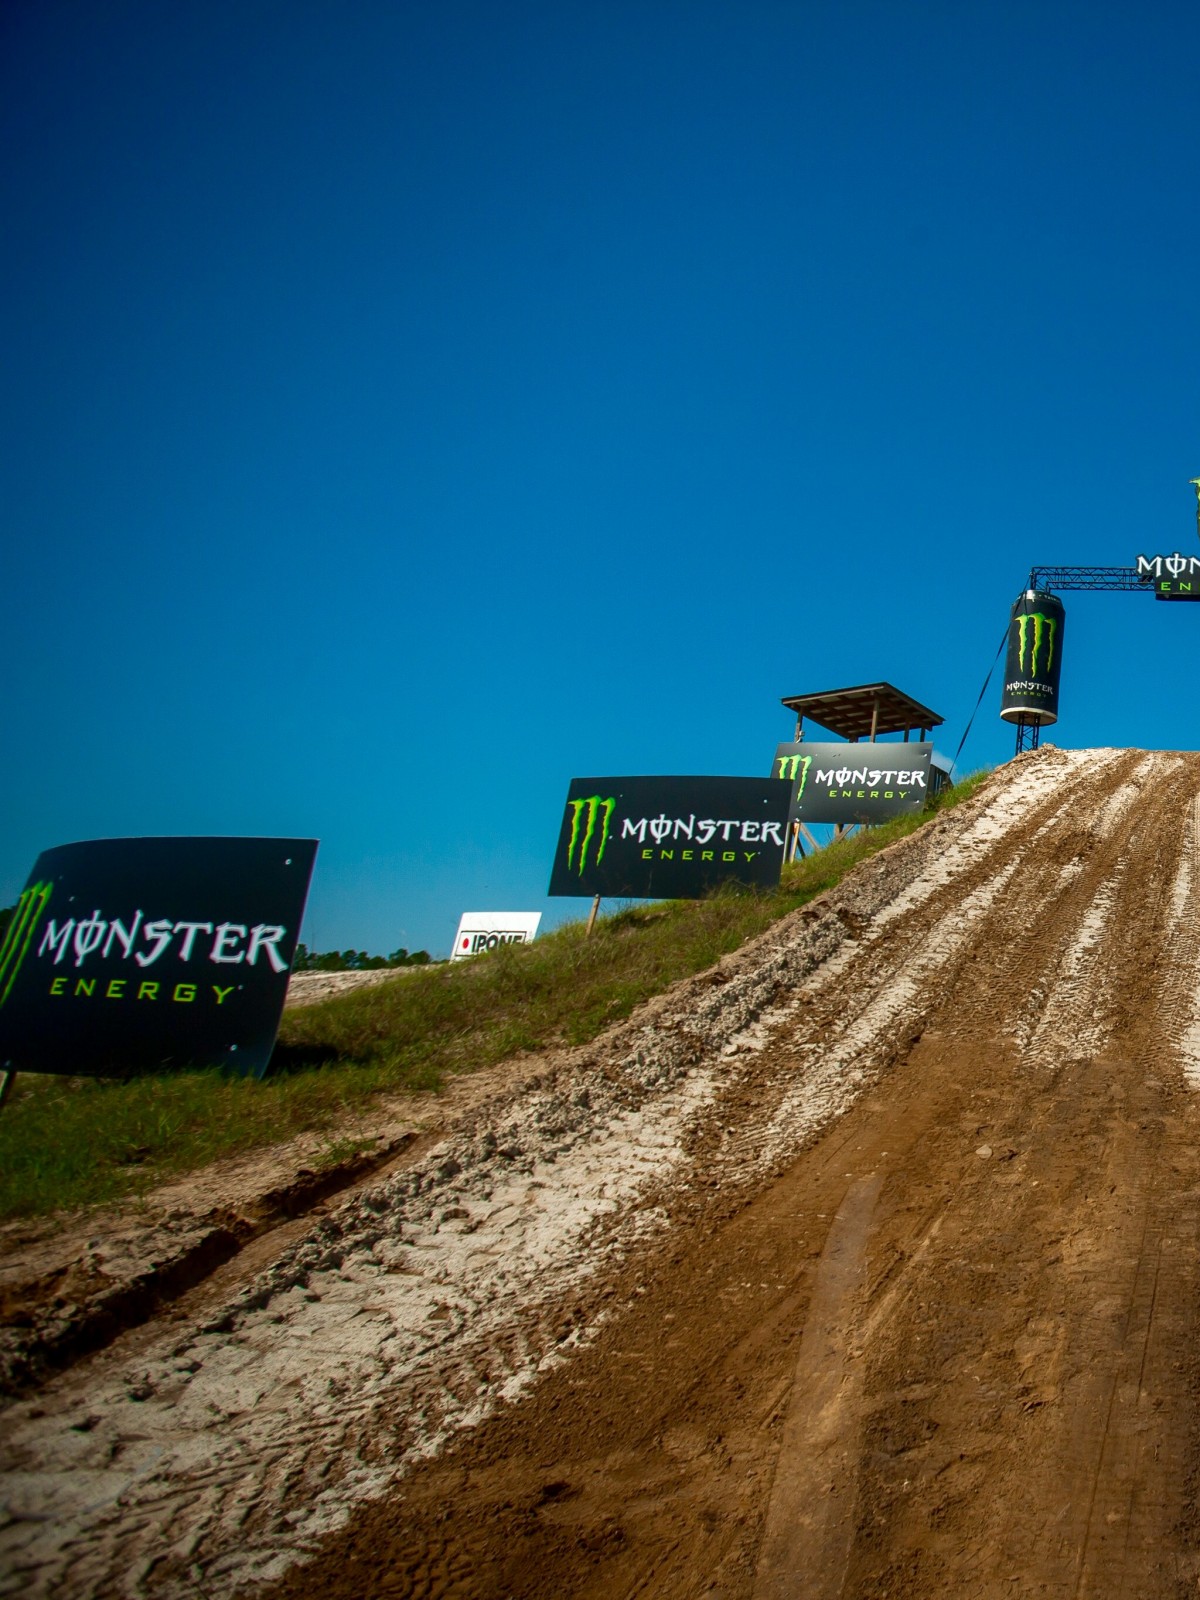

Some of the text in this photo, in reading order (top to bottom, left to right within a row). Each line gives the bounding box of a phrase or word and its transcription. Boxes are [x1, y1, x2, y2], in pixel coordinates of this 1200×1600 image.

[1006, 681, 1054, 695] MONSTER
[815, 765, 926, 788] MONSTER
[828, 789, 906, 799] ENERGY
[621, 813, 785, 847] MONSTER
[641, 849, 757, 863] ENERGY
[38, 909, 288, 973] MONSTER
[50, 976, 234, 1004] ENERGY
